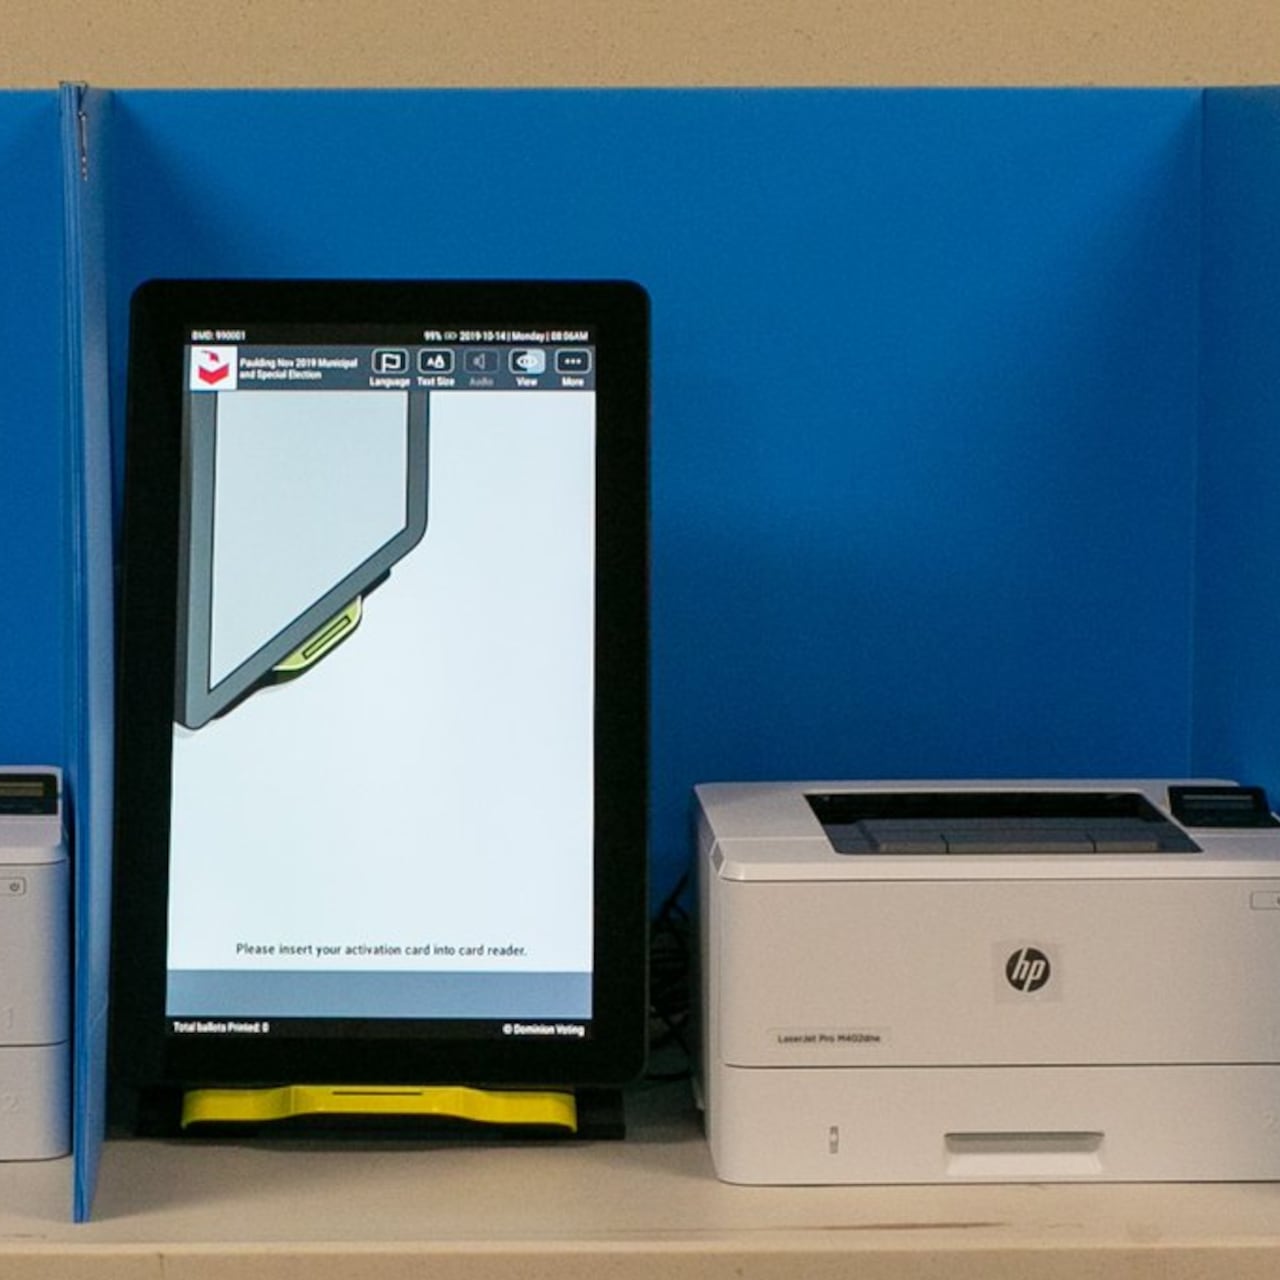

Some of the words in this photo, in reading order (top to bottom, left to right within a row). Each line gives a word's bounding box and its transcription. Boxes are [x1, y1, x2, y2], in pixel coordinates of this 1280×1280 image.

[511, 330, 545, 343] Monday
[239, 358, 276, 370] Paulding
[277, 358, 294, 369] Nov
[295, 358, 317, 369] 2019
[318, 358, 358, 370] Municipal
[239, 369, 256, 380] and
[257, 369, 287, 381] Special
[288, 369, 322, 380] Election
[369, 376, 410, 388] Language
[417, 376, 436, 387] Text
[436, 376, 456, 387] Size
[516, 376, 538, 387] View
[562, 376, 585, 387] More
[236, 943, 275, 955] Please
[279, 943, 313, 955] insert
[315, 946, 342, 958] your
[344, 943, 402, 956] activation
[405, 944, 431, 956] card
[433, 944, 456, 956] into
[459, 945, 485, 956] card
[487, 945, 527, 957] reader.
[1006, 947, 1051, 992] hp
[173, 1021, 196, 1033] Total
[513, 1023, 555, 1035] Dominion
[555, 1023, 585, 1038] Voting
[777, 1034, 817, 1044] LaserJet
[819, 1033, 835, 1043] Pro
